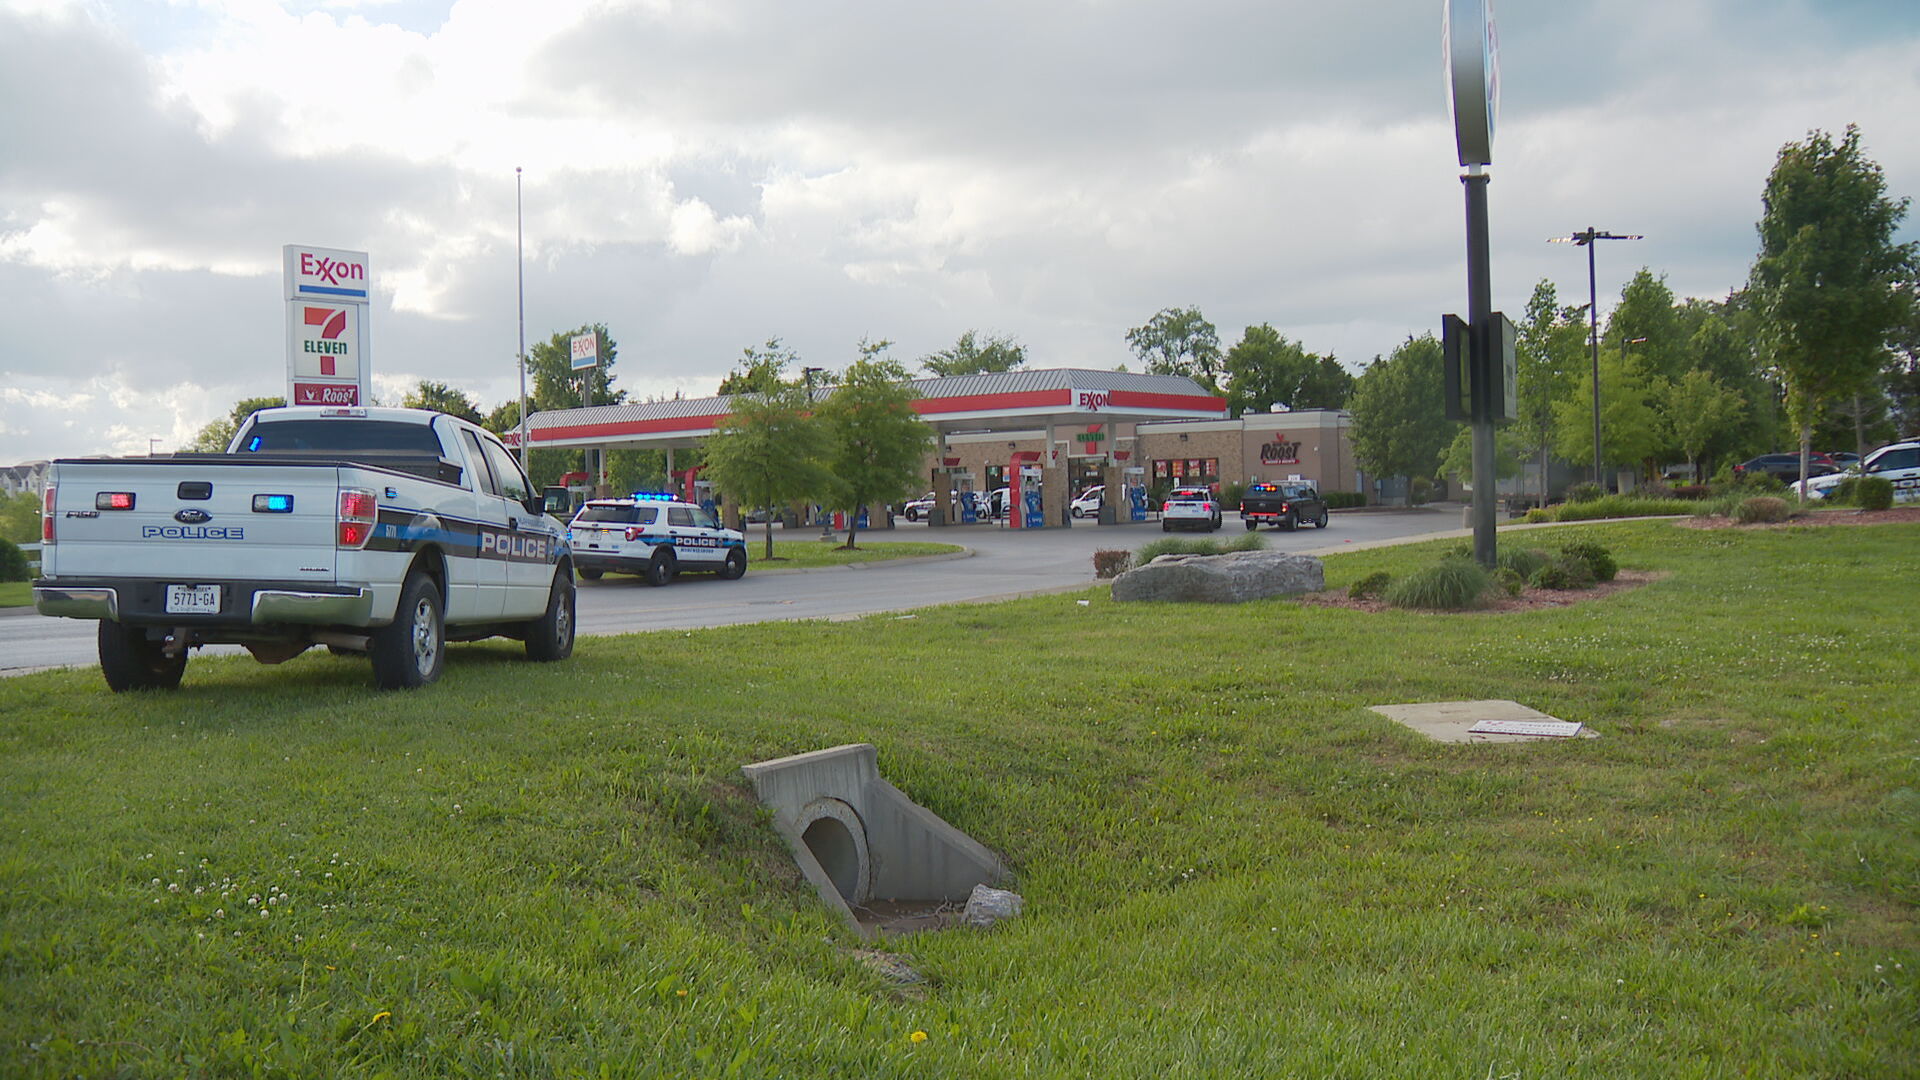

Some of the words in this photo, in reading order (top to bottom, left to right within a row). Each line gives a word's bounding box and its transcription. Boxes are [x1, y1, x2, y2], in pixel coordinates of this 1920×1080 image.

[301, 253, 363, 285] Exxon
[304, 307, 346, 375] 7
[572, 337, 595, 356] EXXON
[1079, 391, 1112, 411] EXXON
[142, 526, 244, 540] POLICE
[675, 537, 716, 547] POLICE
[481, 531, 547, 559] POLICE
[174, 593, 215, 606] 5771-GA
